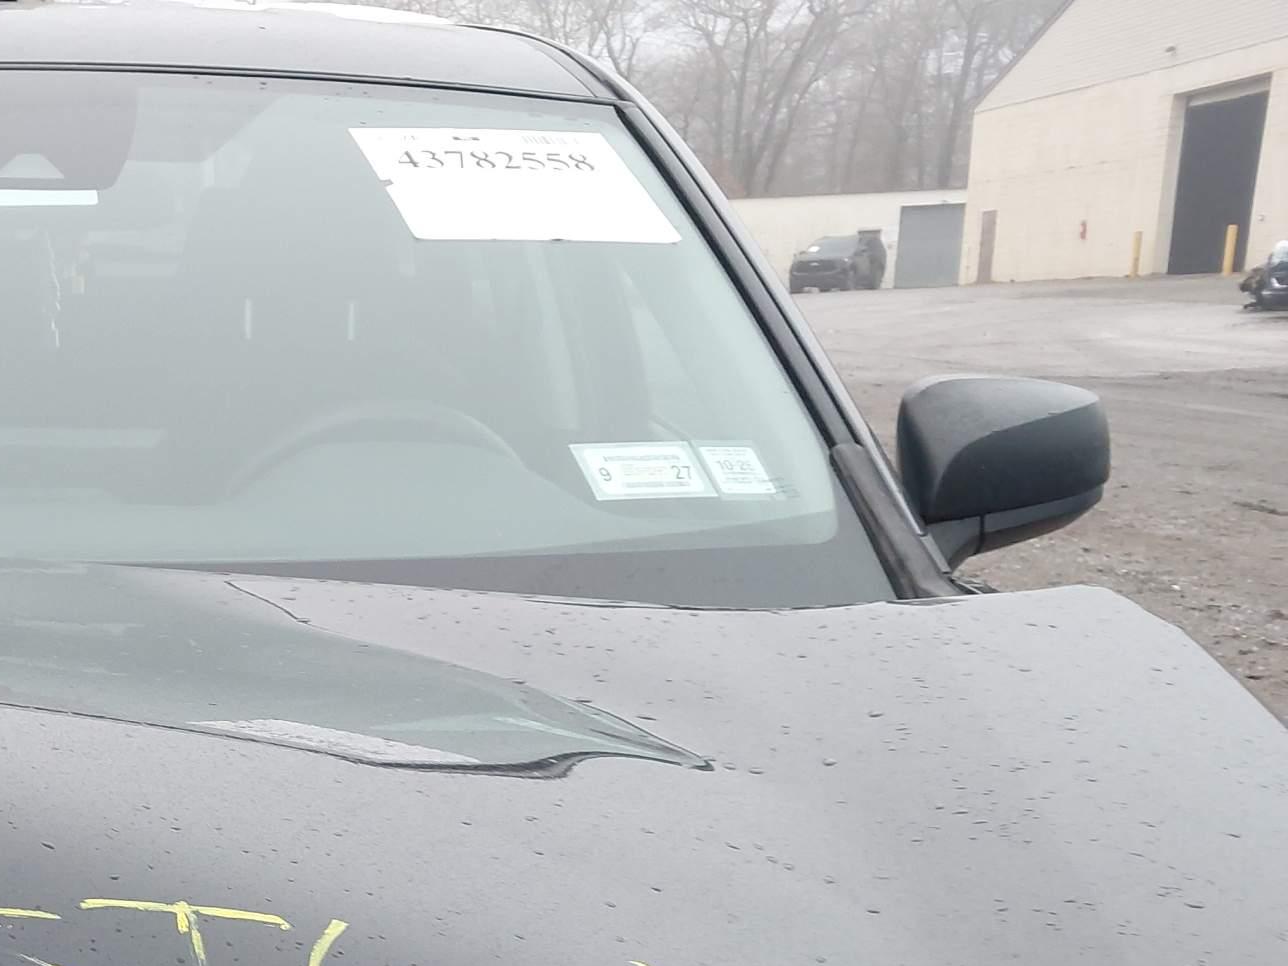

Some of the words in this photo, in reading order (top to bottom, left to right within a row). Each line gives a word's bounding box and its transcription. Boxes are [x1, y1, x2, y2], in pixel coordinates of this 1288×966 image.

[398, 150, 596, 171] 43782558
[598, 466, 613, 482] 9
[671, 465, 693, 480] 27
